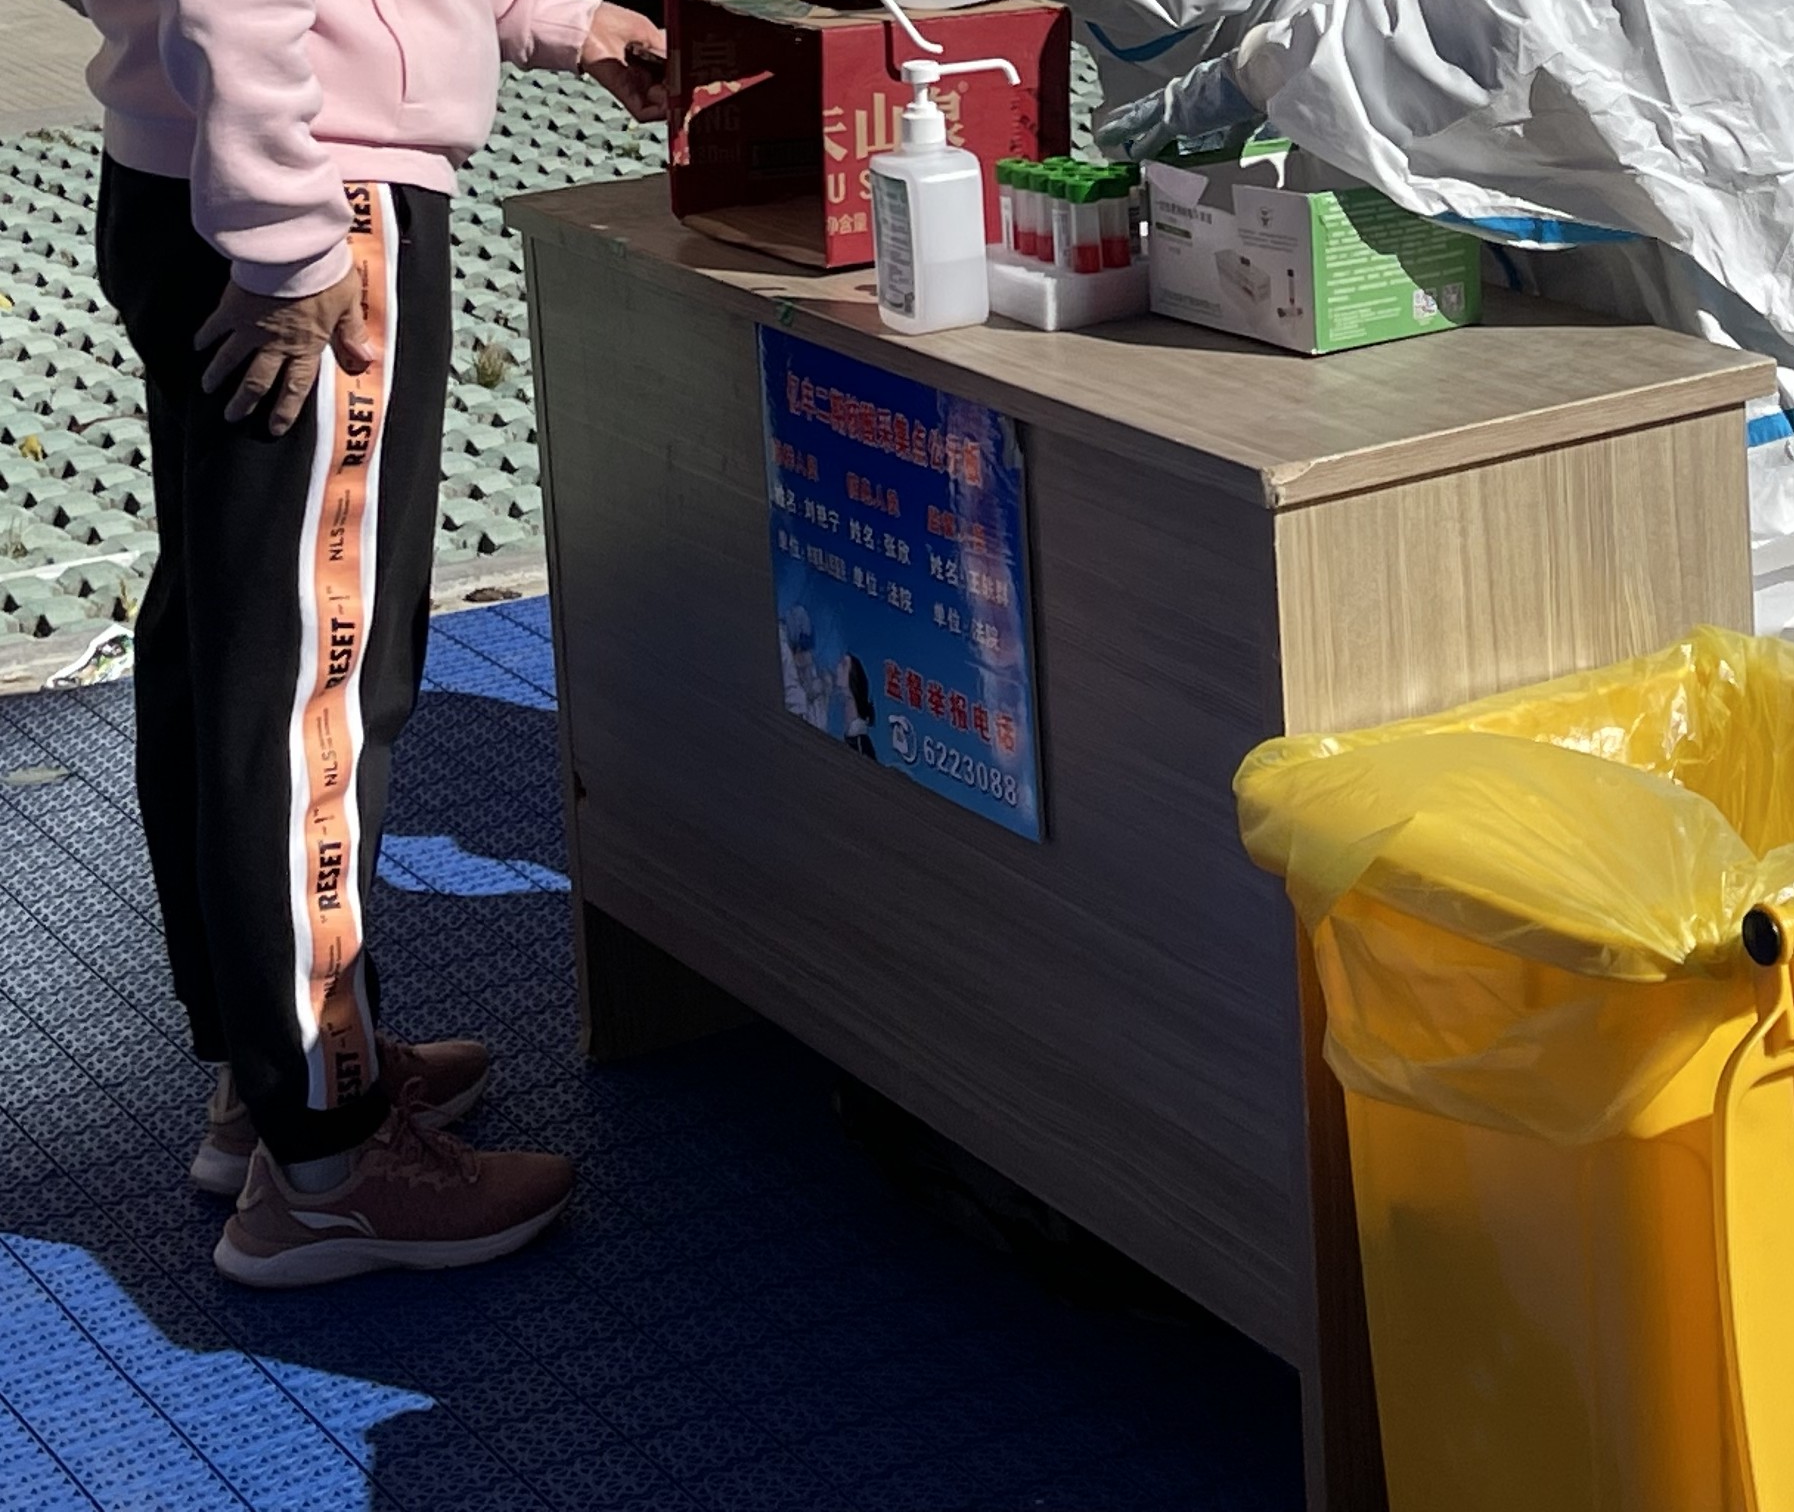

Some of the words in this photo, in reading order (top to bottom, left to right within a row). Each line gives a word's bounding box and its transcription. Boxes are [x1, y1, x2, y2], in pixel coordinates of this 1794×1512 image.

[882, 657, 1019, 754] 监督举报电话
[921, 731, 1020, 808] 6223088
